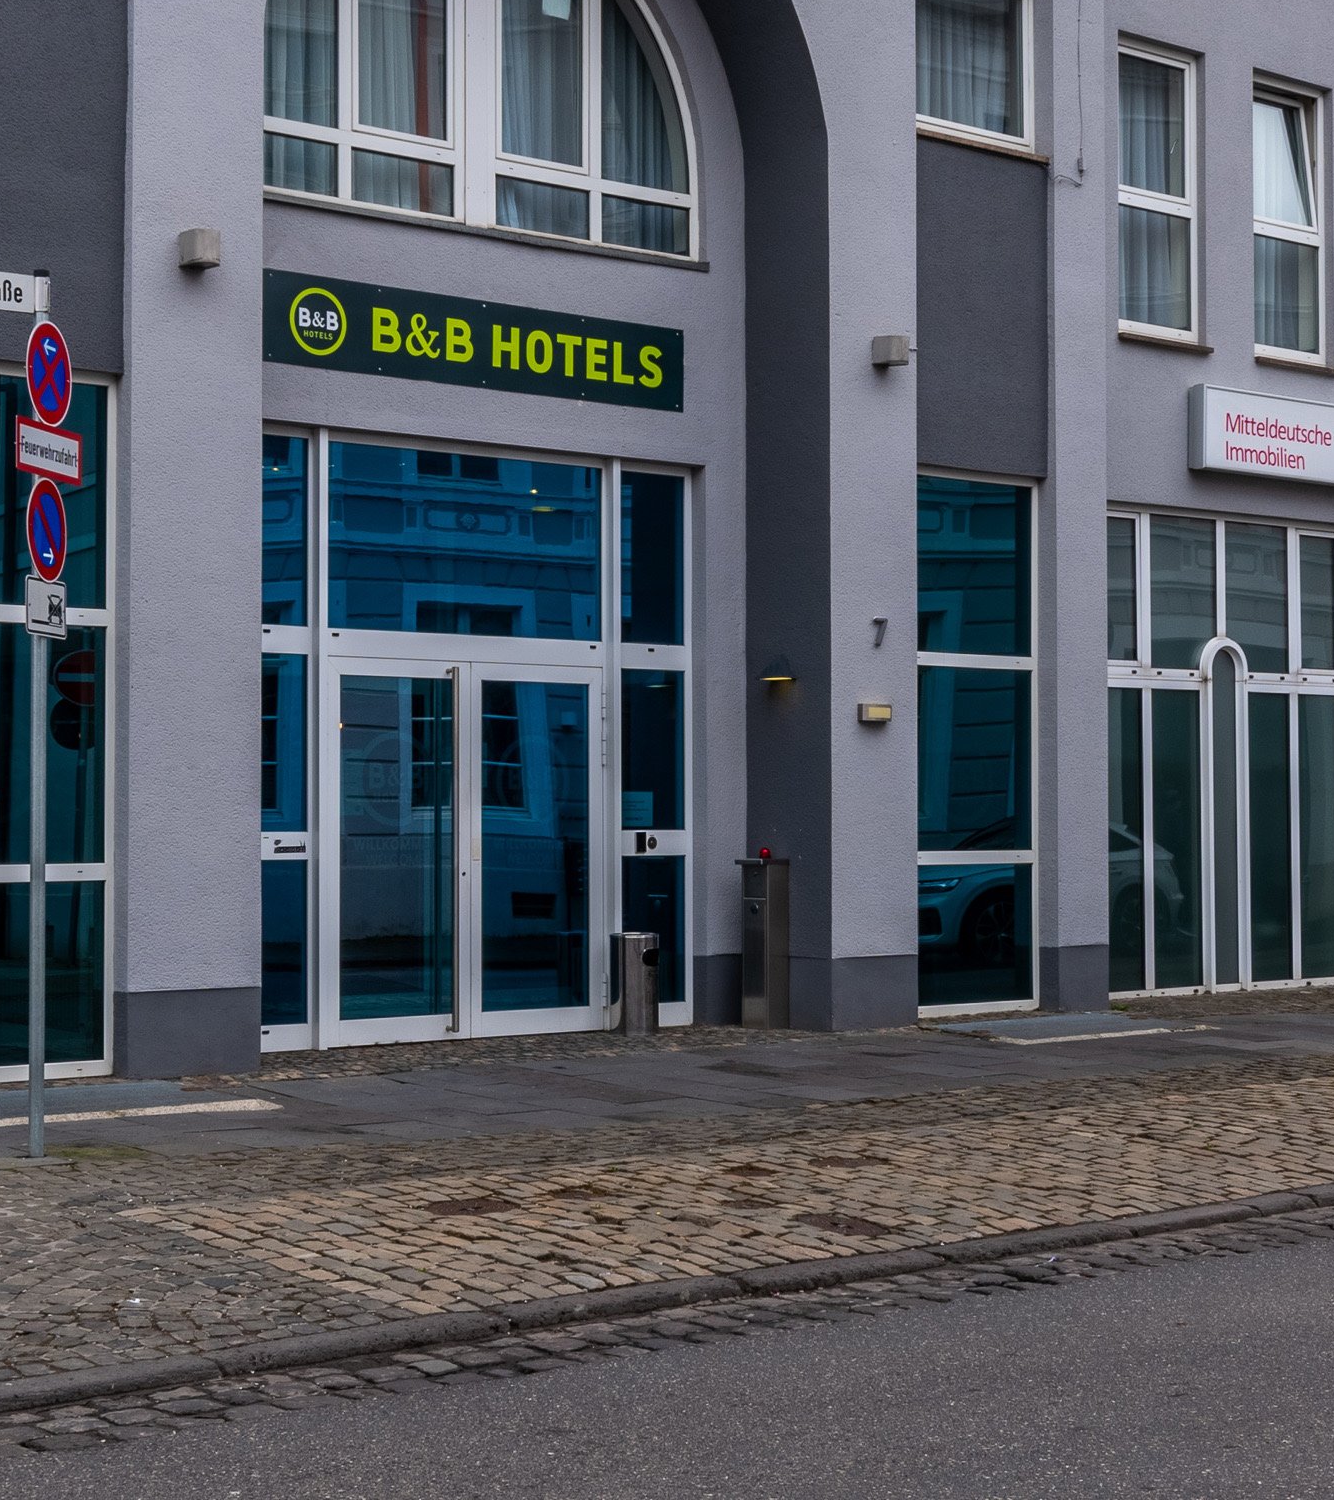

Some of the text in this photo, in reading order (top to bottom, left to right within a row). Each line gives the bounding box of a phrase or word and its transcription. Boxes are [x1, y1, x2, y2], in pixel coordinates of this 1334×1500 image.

[298, 307, 339, 331] B&B
[303, 330, 333, 340] HOTELS
[372, 307, 663, 389] B&B HOTELS
[1225, 412, 1332, 447] Mitteldeutsche
[20, 435, 78, 468] Feuerwehrzufahrt
[1225, 441, 1306, 470] Immobilien
[873, 616, 888, 647] 7
